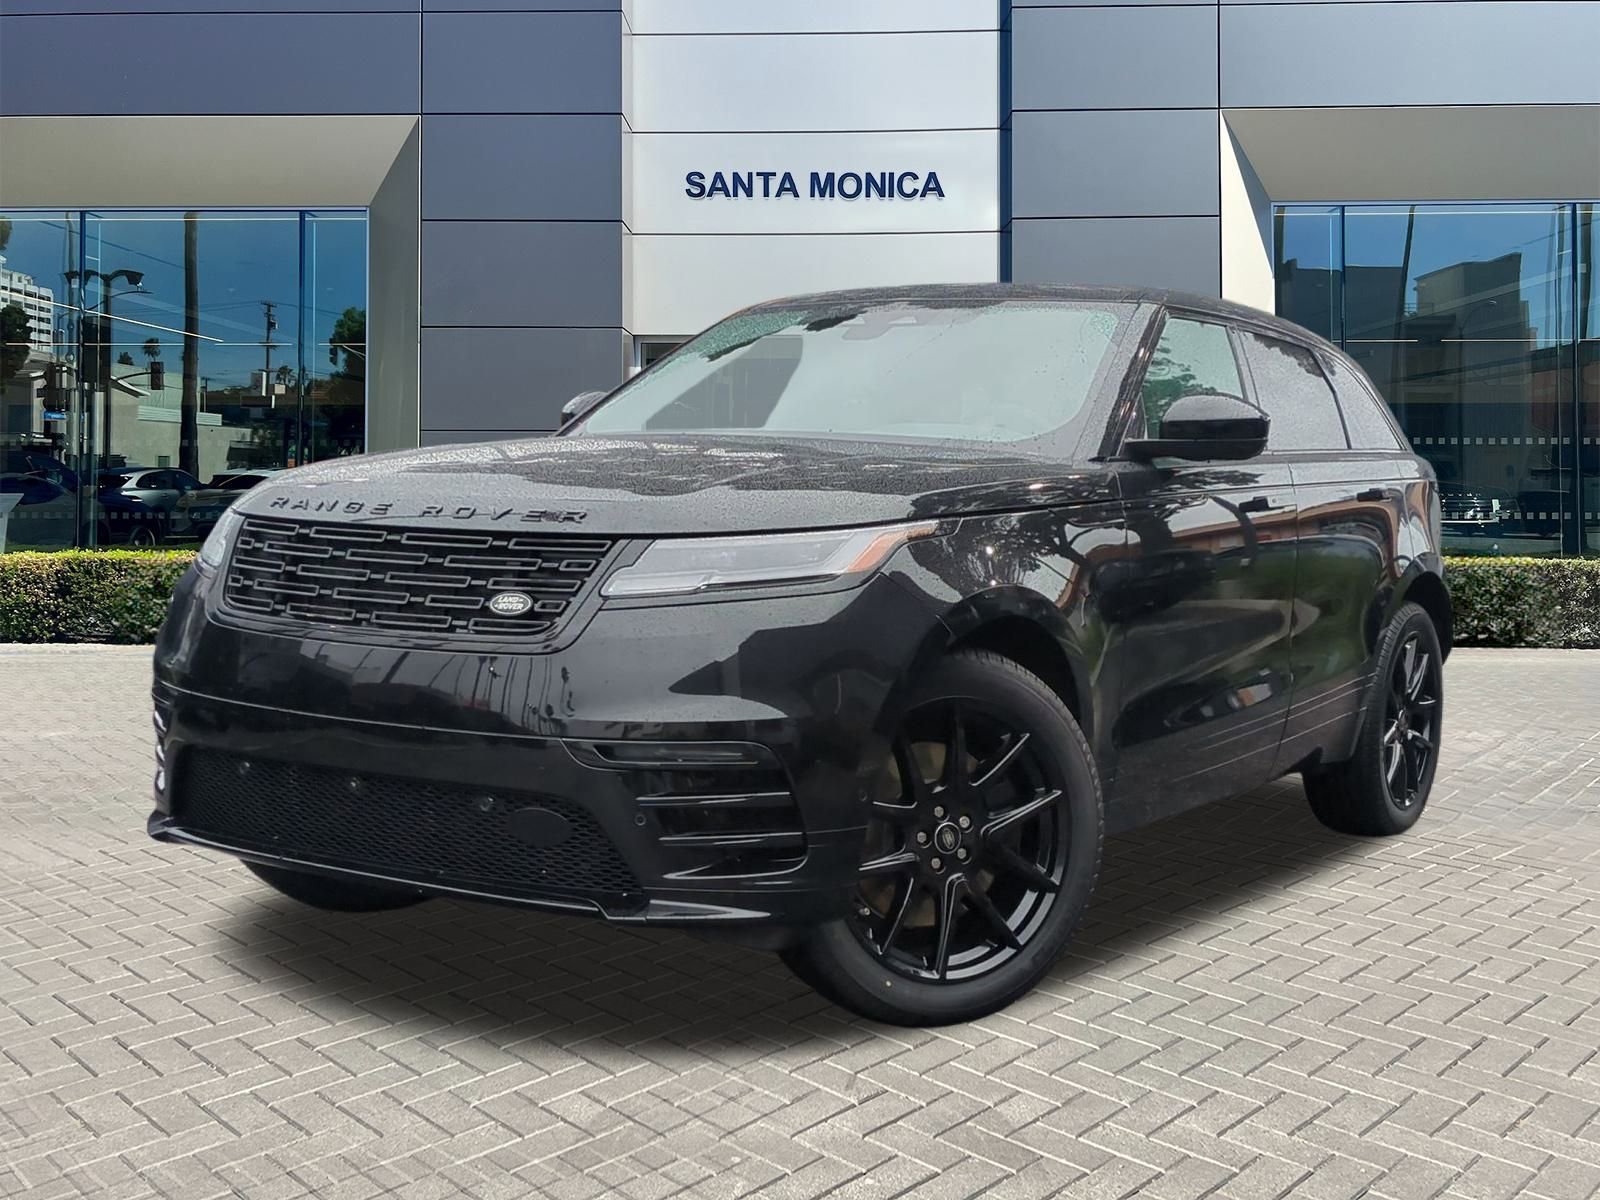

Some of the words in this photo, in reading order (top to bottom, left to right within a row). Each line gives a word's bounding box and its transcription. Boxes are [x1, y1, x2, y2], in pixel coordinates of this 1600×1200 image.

[685, 171, 800, 199] SANTA
[809, 171, 945, 199] MONICA
[269, 496, 394, 515] RANGE
[418, 504, 589, 524] ROVER
